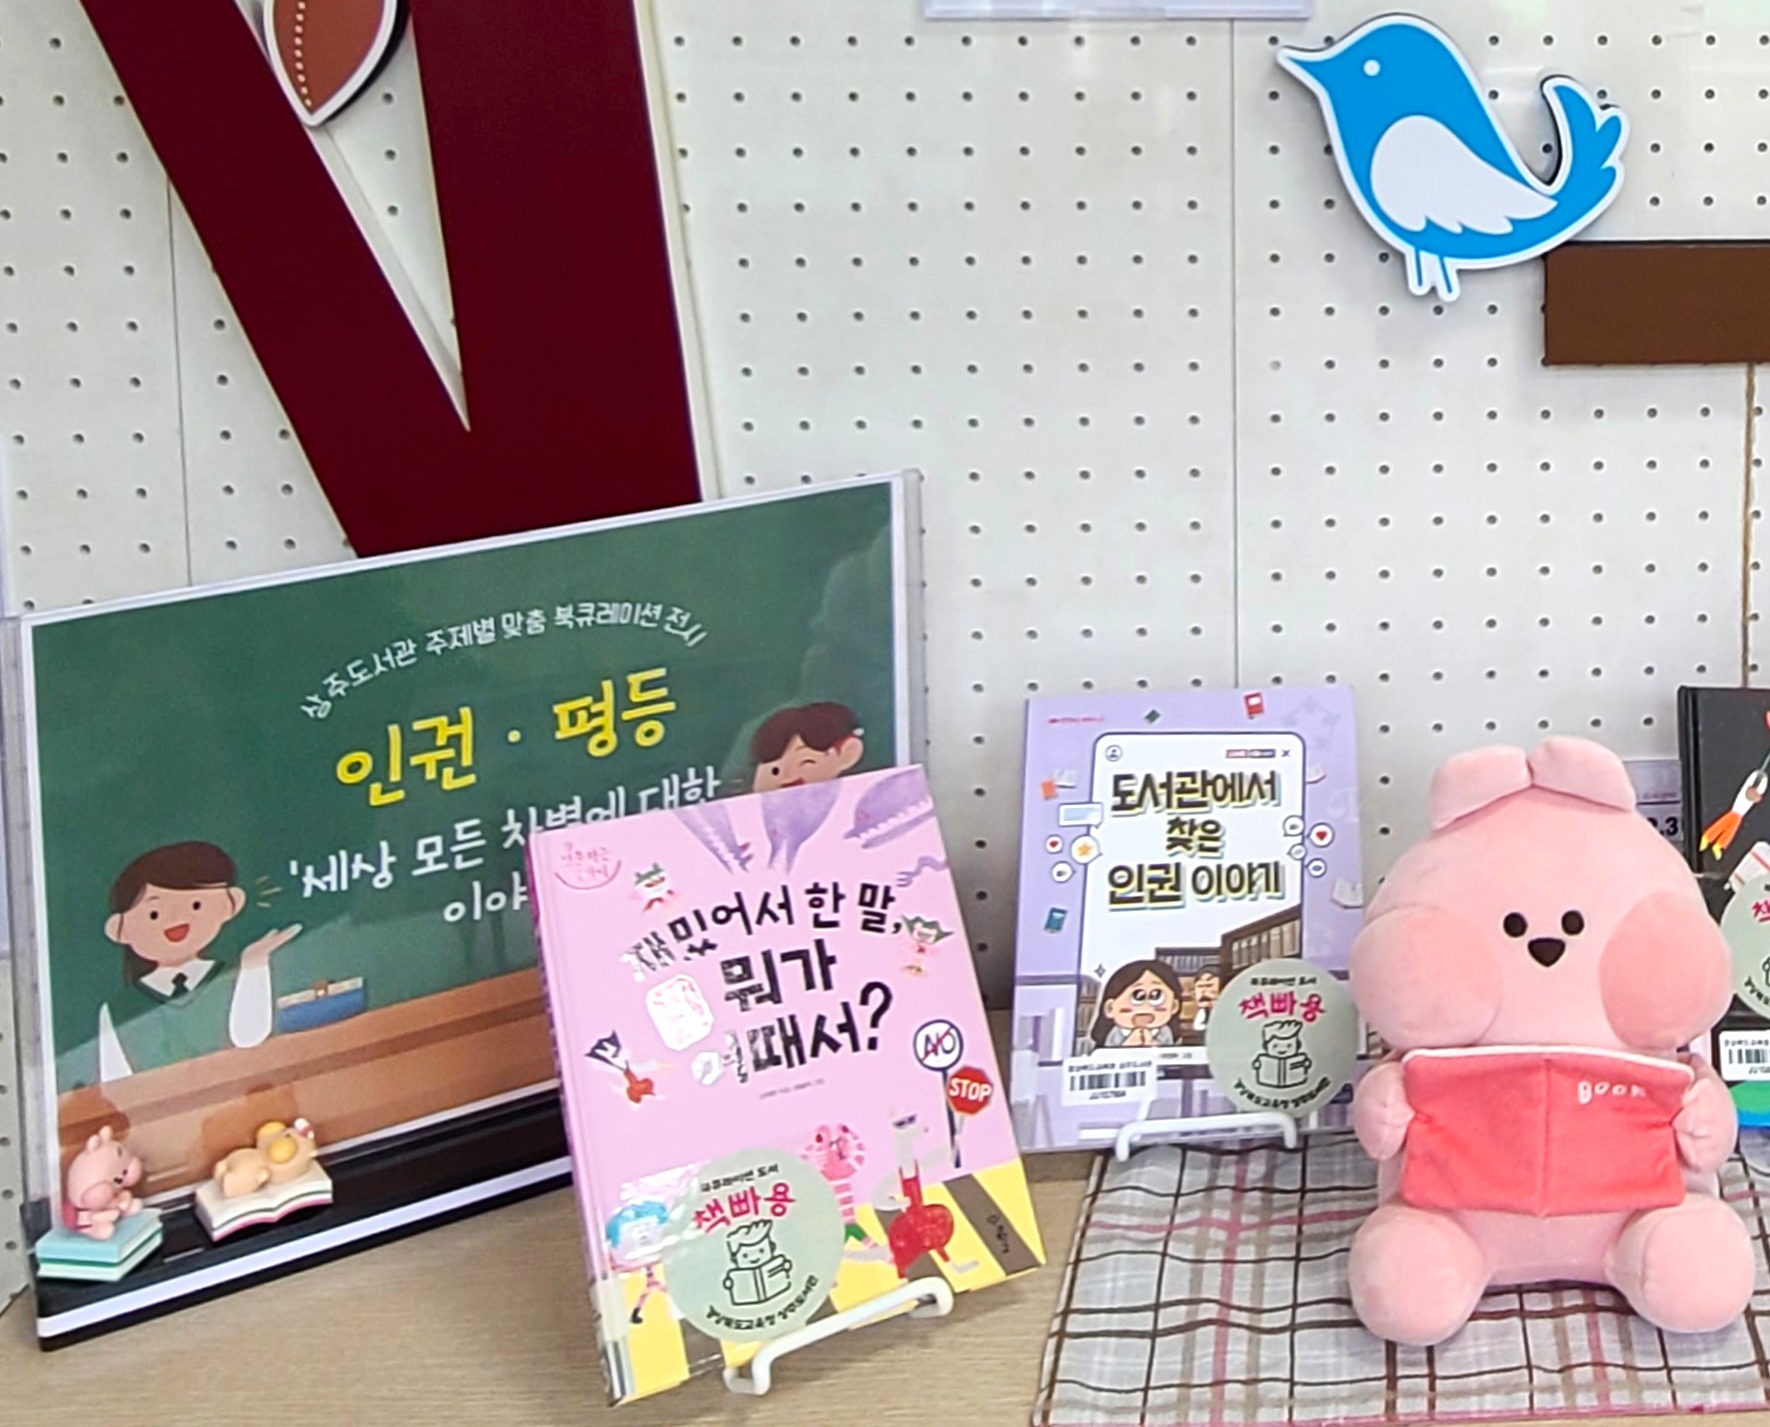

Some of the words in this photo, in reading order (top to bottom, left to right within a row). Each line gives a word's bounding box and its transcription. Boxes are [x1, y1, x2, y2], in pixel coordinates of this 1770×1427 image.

[301, 638, 418, 720] 상주도서관
[425, 618, 496, 655] 주제별
[500, 609, 547, 640] 맞춤
[554, 602, 663, 630] 북큐레이션
[664, 606, 708, 647] 전시
[336, 706, 476, 806] 인권
[552, 667, 677, 757] 평등
[1110, 769, 1282, 816] 도서관에서
[411, 818, 487, 876] 모든
[1165, 816, 1225, 858] 찾은
[805, 882, 847, 929] 한
[857, 883, 902, 936] 말,
[1107, 862, 1186, 911] 인권
[1191, 860, 1286, 905] 이야기
[719, 938, 838, 1013] 뭐가
[1238, 991, 1326, 1023] 책빠용
[948, 1078, 992, 1102] STOP
[692, 1182, 797, 1235] 책빠용
